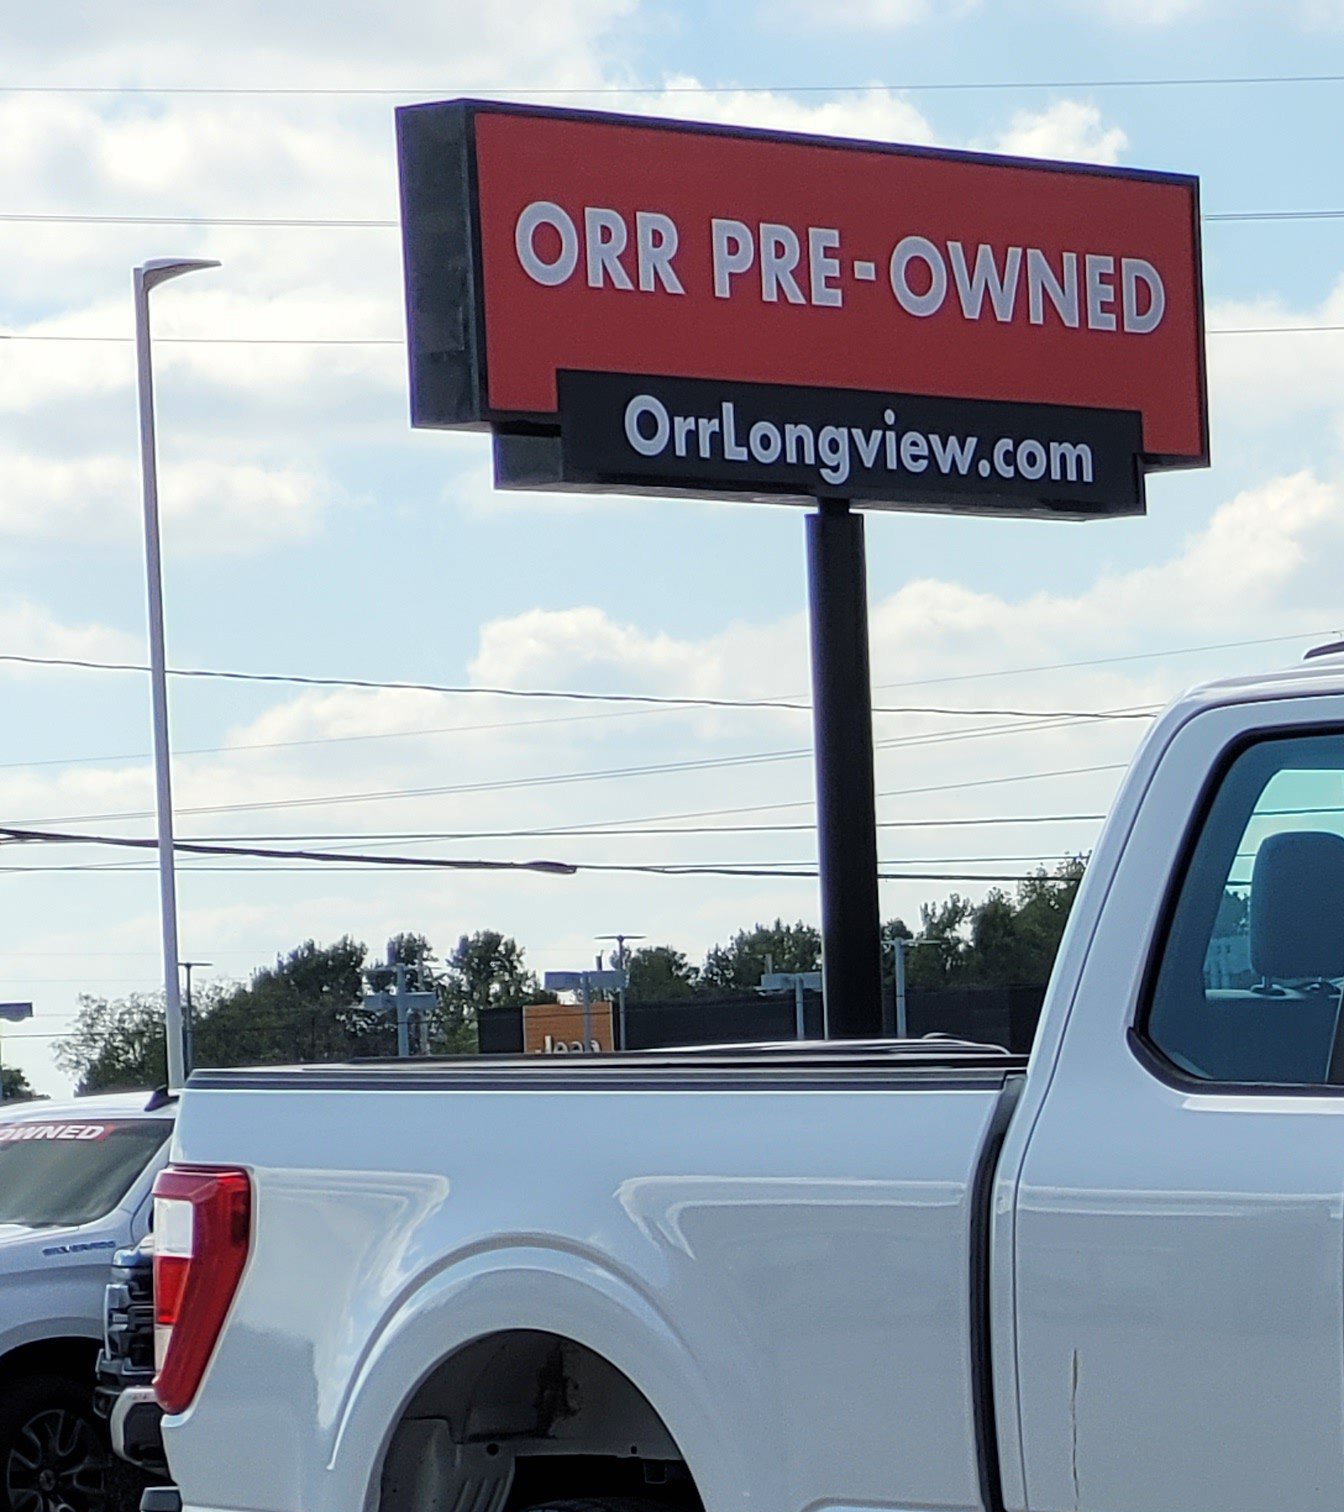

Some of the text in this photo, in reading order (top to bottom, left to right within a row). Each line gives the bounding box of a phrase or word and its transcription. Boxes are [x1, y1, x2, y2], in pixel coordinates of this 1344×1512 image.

[515, 201, 1165, 334] ORR PRE-OWNED
[624, 394, 1093, 485] OrrLongview.com
